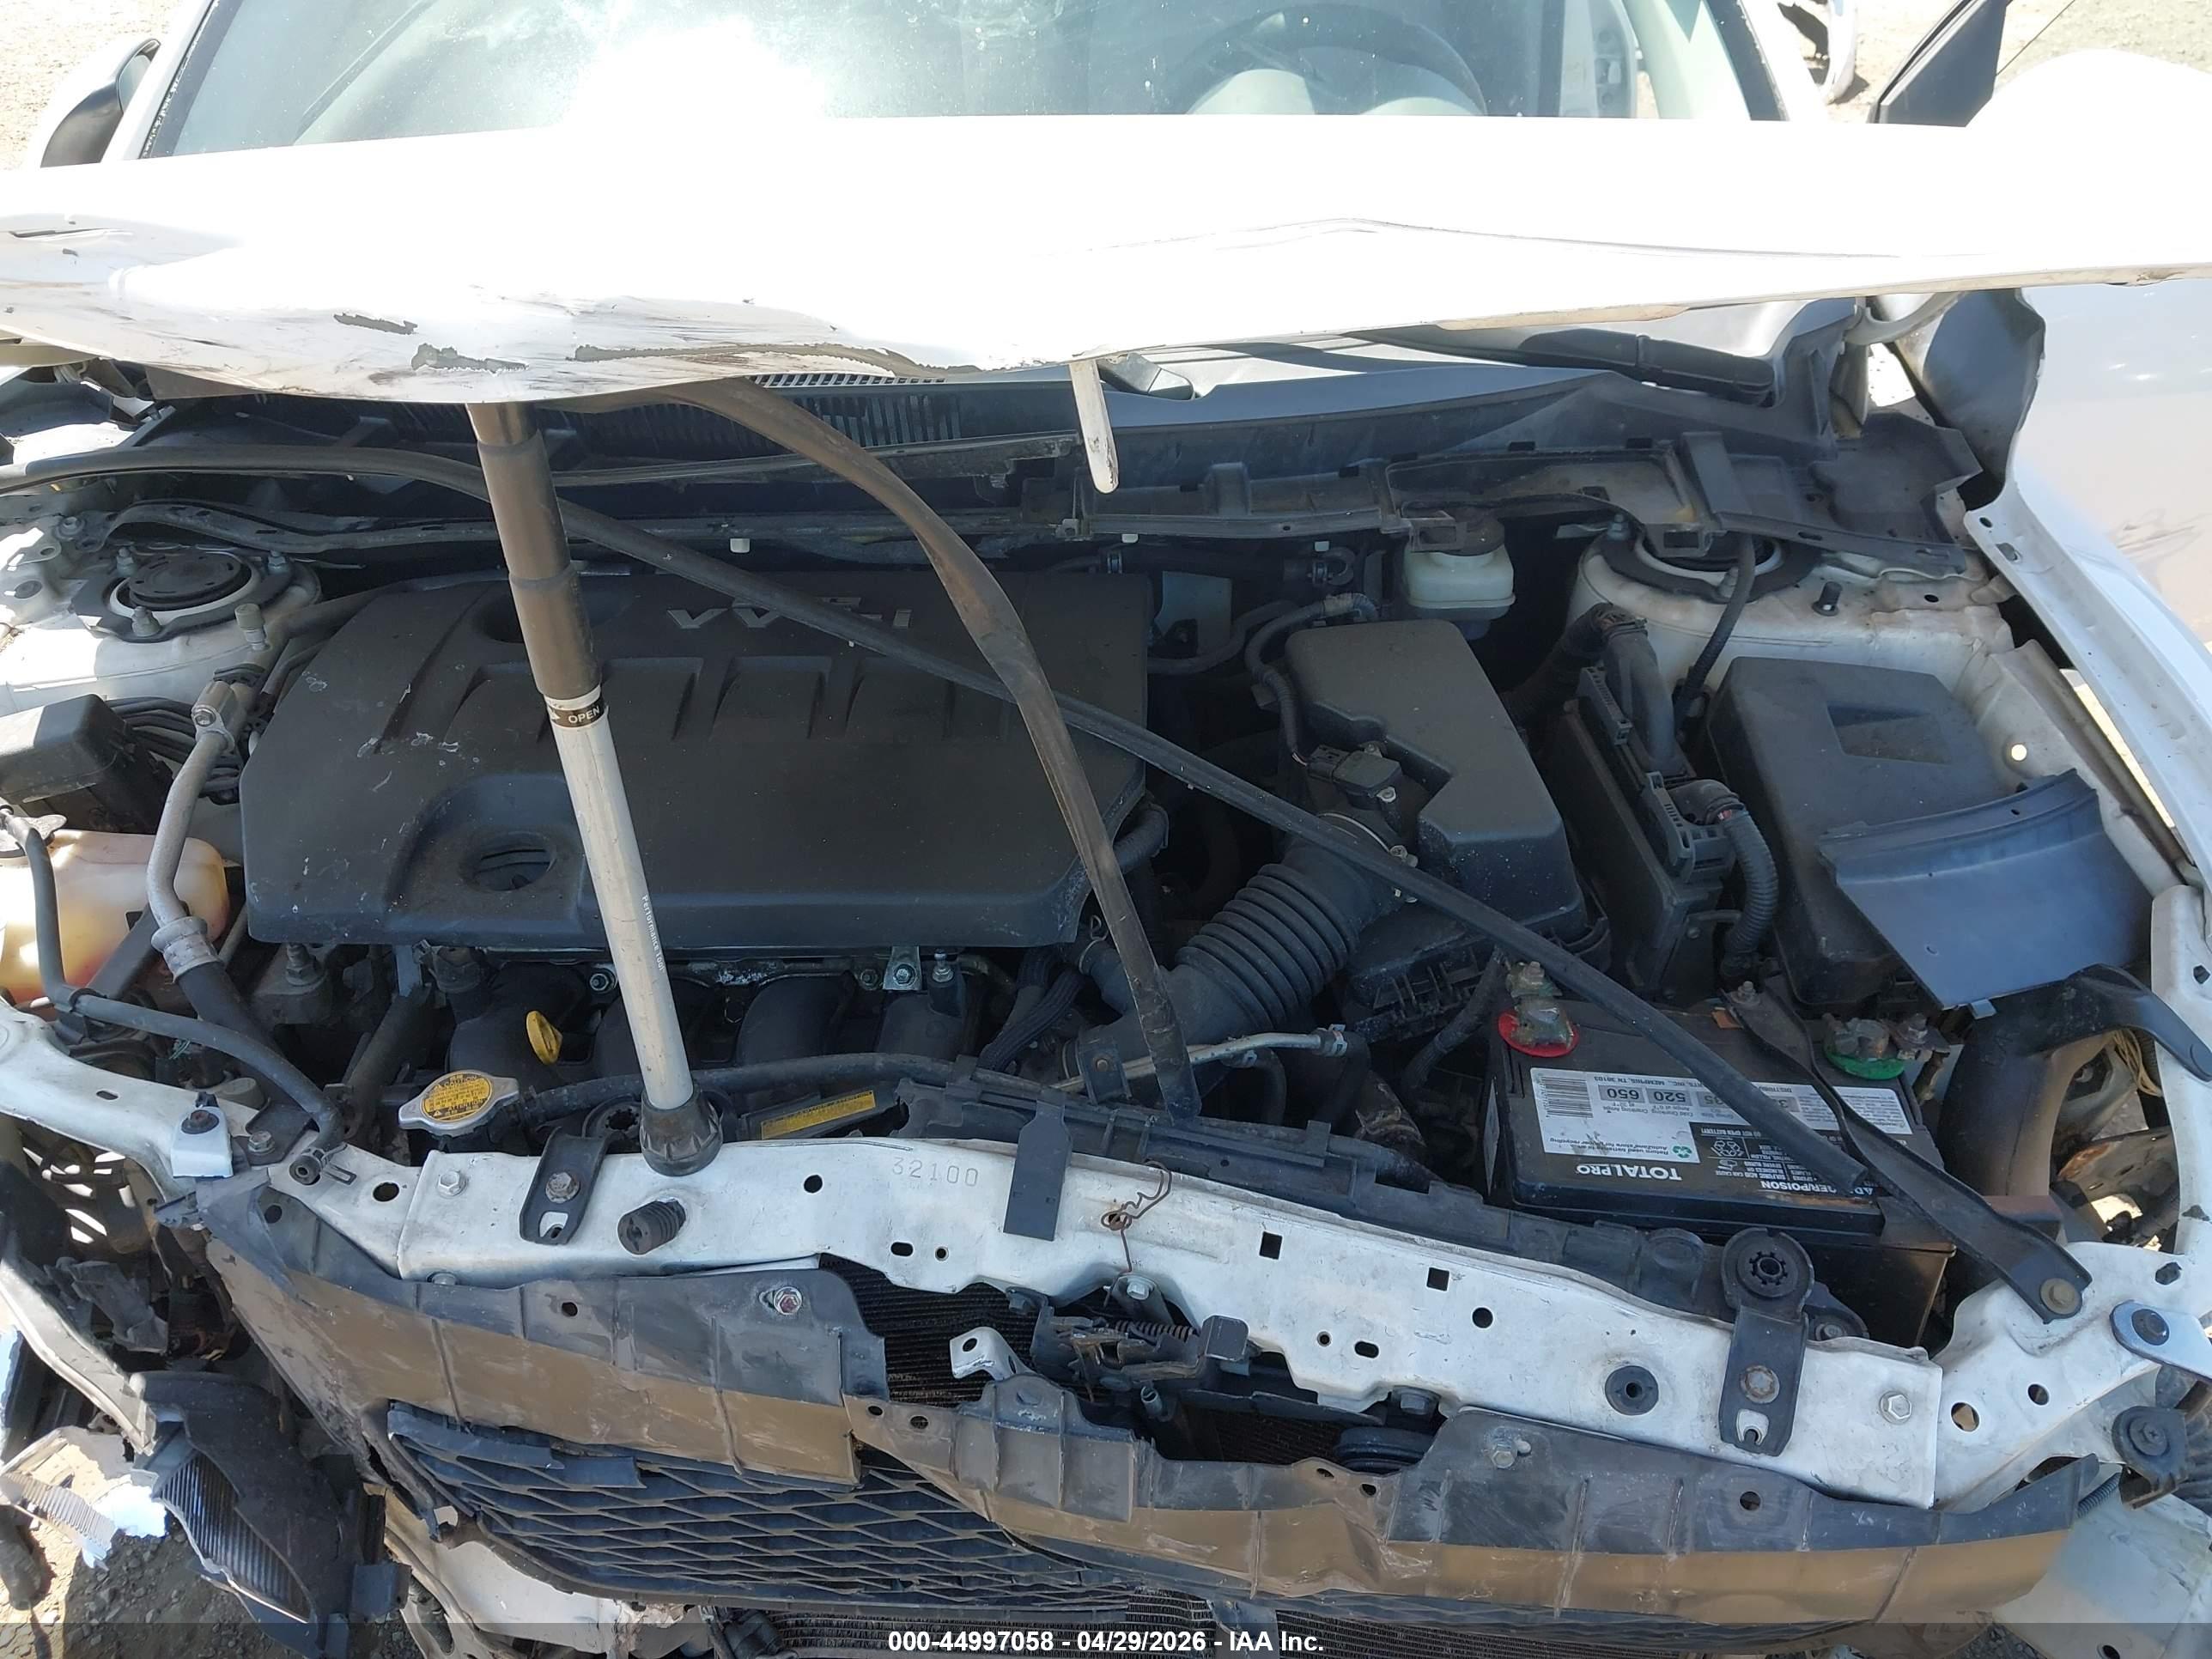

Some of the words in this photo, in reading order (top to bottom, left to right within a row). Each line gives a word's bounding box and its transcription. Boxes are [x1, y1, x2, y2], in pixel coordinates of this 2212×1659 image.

[568, 705, 600, 723] OPEN
[641, 895, 659, 951] Performance
[1607, 1088, 1639, 1100] 650
[1653, 1091, 1686, 1103] 520
[892, 1156, 979, 1187] 32100
[1577, 1164, 1682, 1181] TOTALPRO
